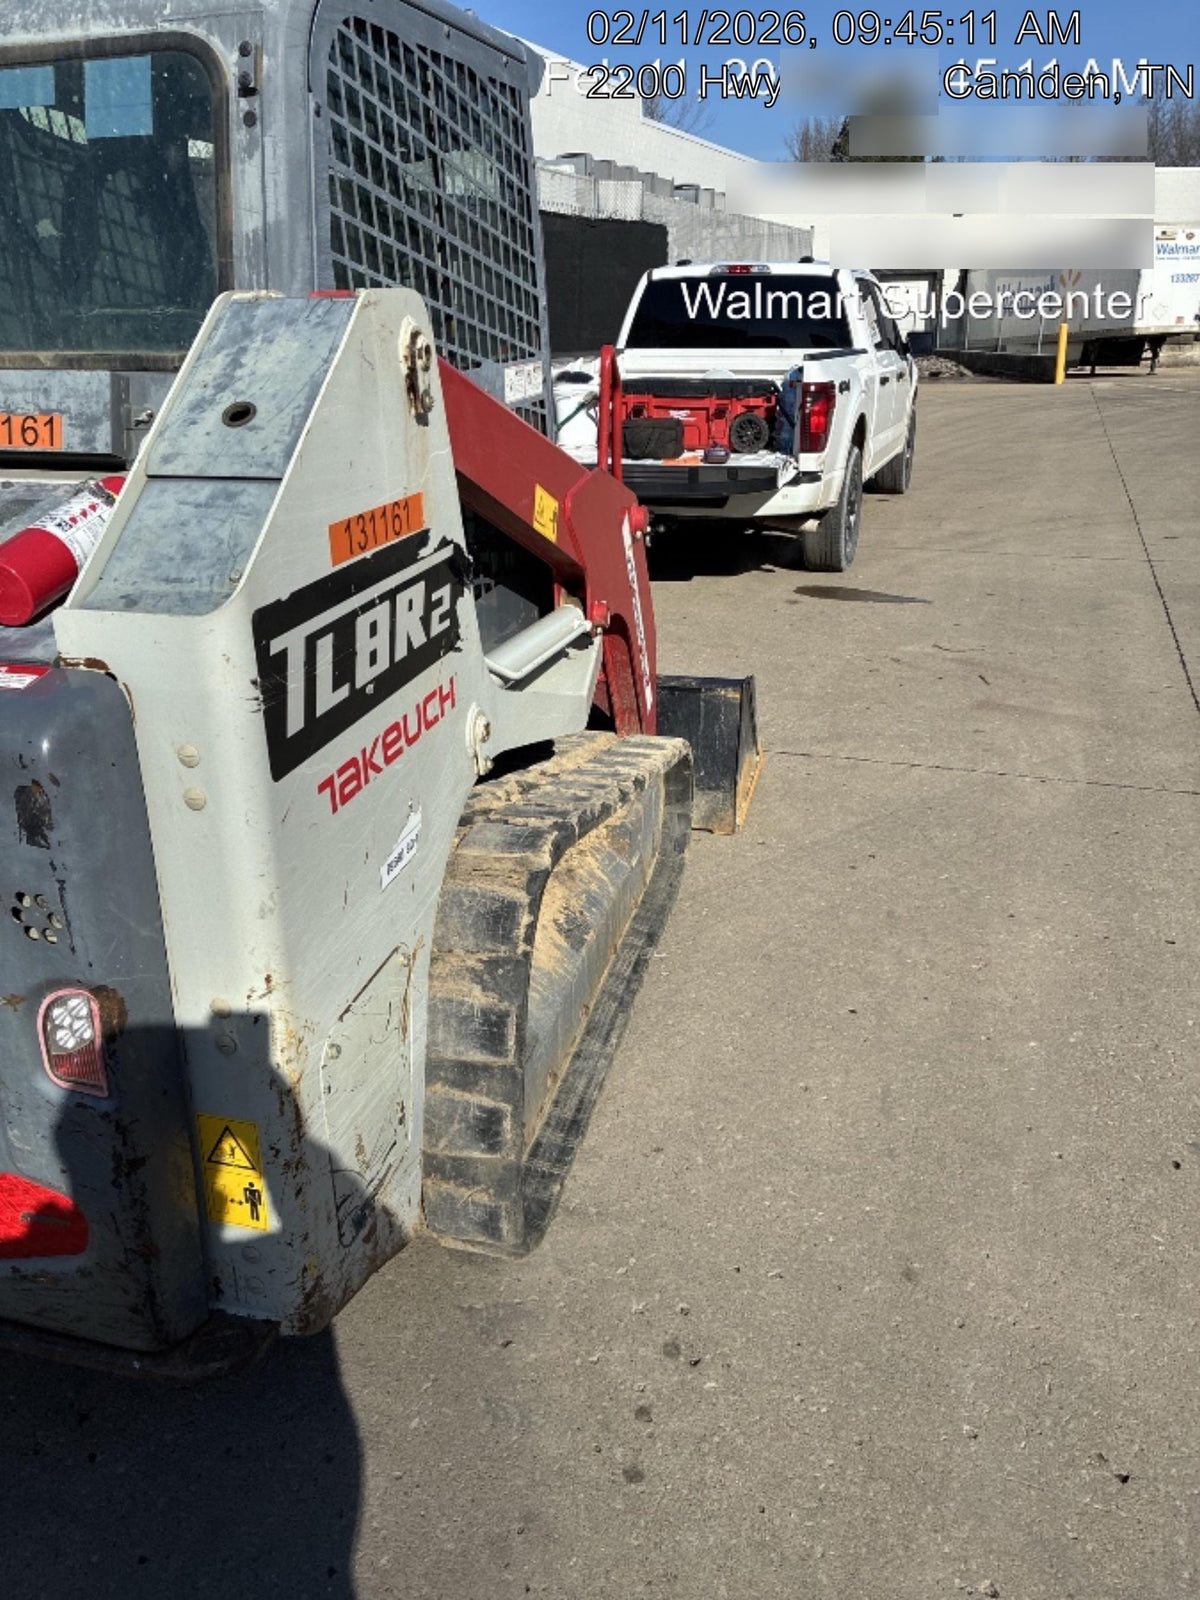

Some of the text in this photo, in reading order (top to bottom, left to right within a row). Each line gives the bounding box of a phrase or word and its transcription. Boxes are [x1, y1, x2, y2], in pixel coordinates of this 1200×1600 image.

[1156, 242, 1200, 255] Walmar
[0, 414, 54, 447] 161
[344, 498, 410, 555] 131161
